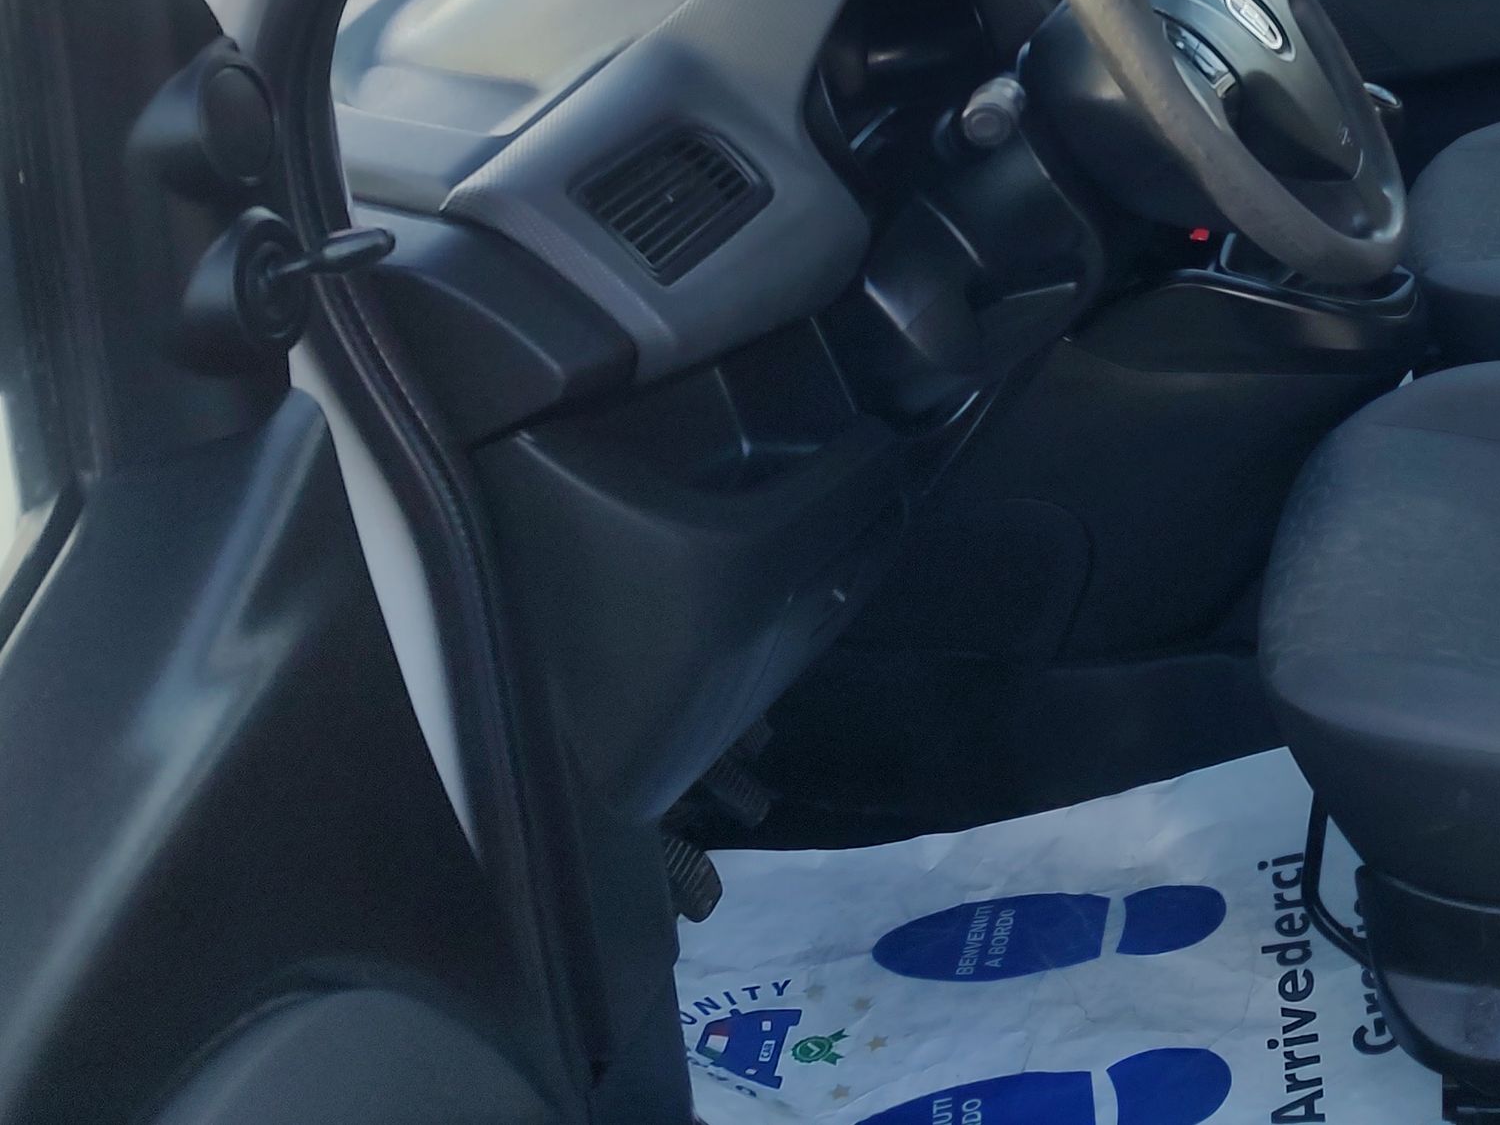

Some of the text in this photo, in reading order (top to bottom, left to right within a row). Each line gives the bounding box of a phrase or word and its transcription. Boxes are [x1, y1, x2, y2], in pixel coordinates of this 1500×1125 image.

[955, 905, 994, 975] BENVENUTI
[985, 908, 1017, 968] A BORDO
[1257, 852, 1326, 1124] Arrivederci
